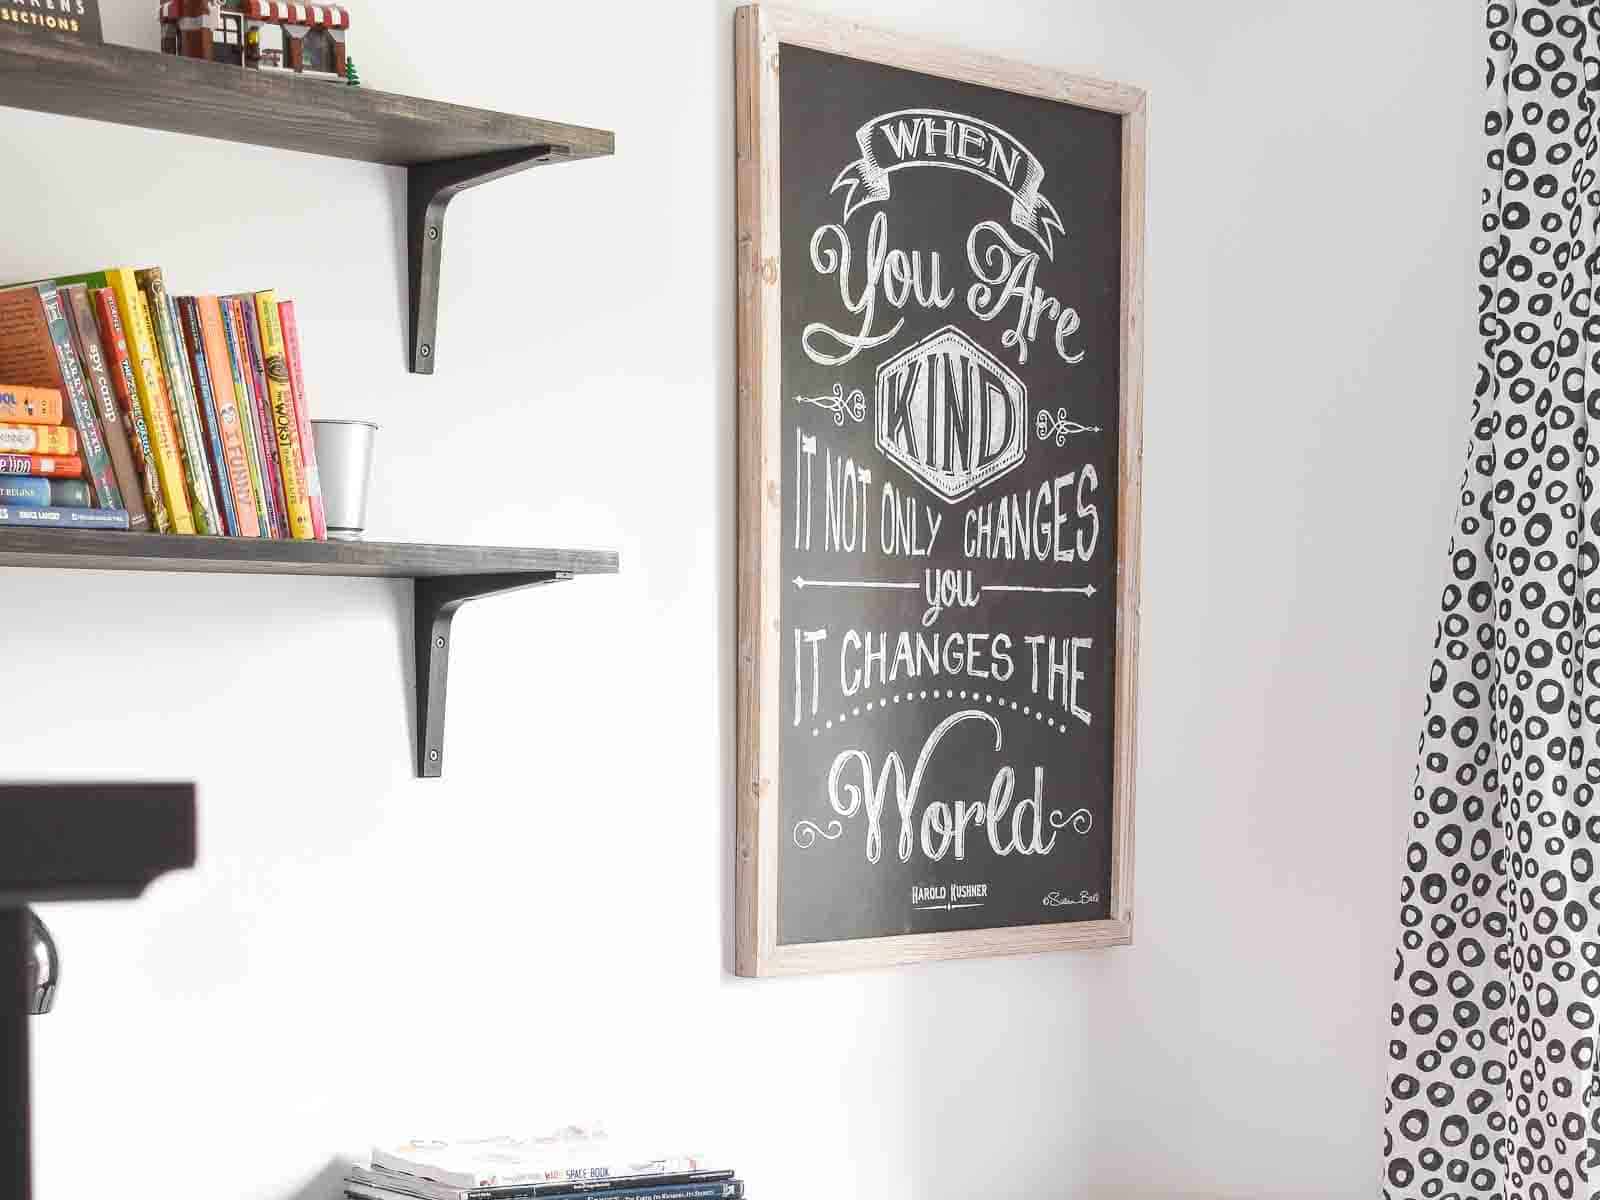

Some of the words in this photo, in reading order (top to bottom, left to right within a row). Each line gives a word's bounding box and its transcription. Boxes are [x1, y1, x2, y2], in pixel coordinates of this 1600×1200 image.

[0, 8, 80, 32] SECTIONS
[881, 117, 1022, 185] WHEN
[802, 211, 955, 366] You
[966, 220, 1085, 364] Are
[63, 343, 85, 394] HARRY
[79, 398, 102, 453] POTTER
[89, 343, 105, 374] spy
[98, 377, 117, 422] camp
[884, 353, 1016, 473] KIND
[11, 455, 31, 473] lion
[275, 401, 291, 449] WORST
[795, 428, 816, 550] IT
[825, 448, 872, 552] NOT
[881, 480, 941, 556] ONLY
[964, 463, 1099, 562] CHANGES
[922, 568, 979, 627] you
[794, 629, 827, 728] IT
[841, 629, 1014, 698] CHANGES
[1024, 636, 1093, 727] THE
[828, 709, 1057, 864] World
[912, 886, 946, 904] HAROLD
[950, 884, 988, 902] KUSHNER
